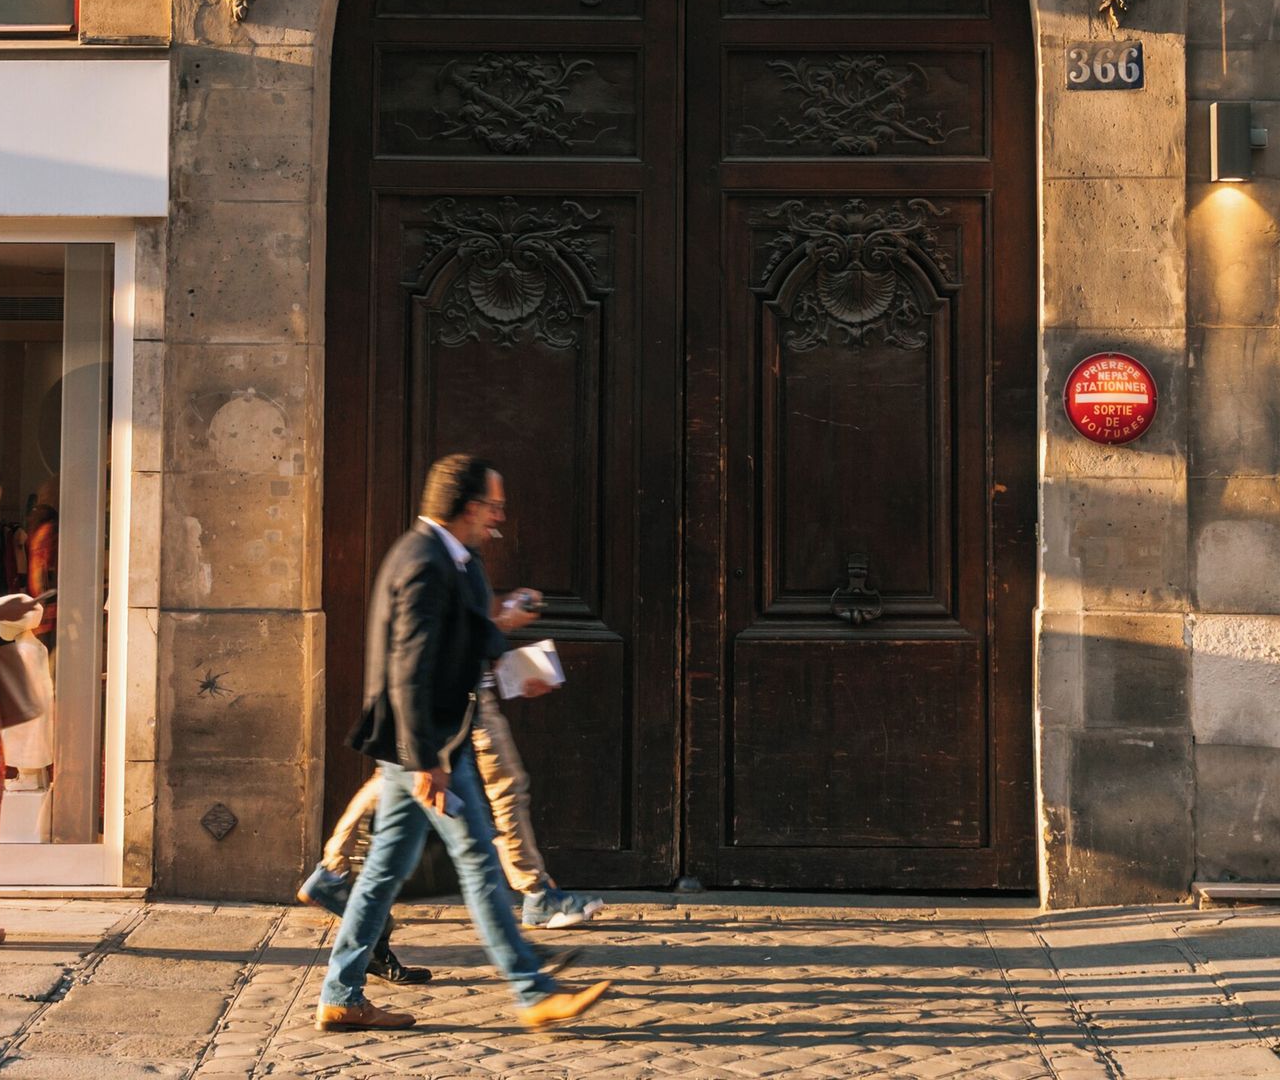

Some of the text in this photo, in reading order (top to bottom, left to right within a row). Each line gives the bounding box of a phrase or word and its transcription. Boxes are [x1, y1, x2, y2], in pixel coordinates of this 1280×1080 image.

[1069, 48, 1139, 83] 366
[1126, 366, 1141, 380] DE
[1075, 381, 1147, 393] STATIONNER
[1093, 404, 1132, 415] SORTIE
[1080, 415, 1145, 438] VOITURES
[1105, 417, 1120, 427] DE
